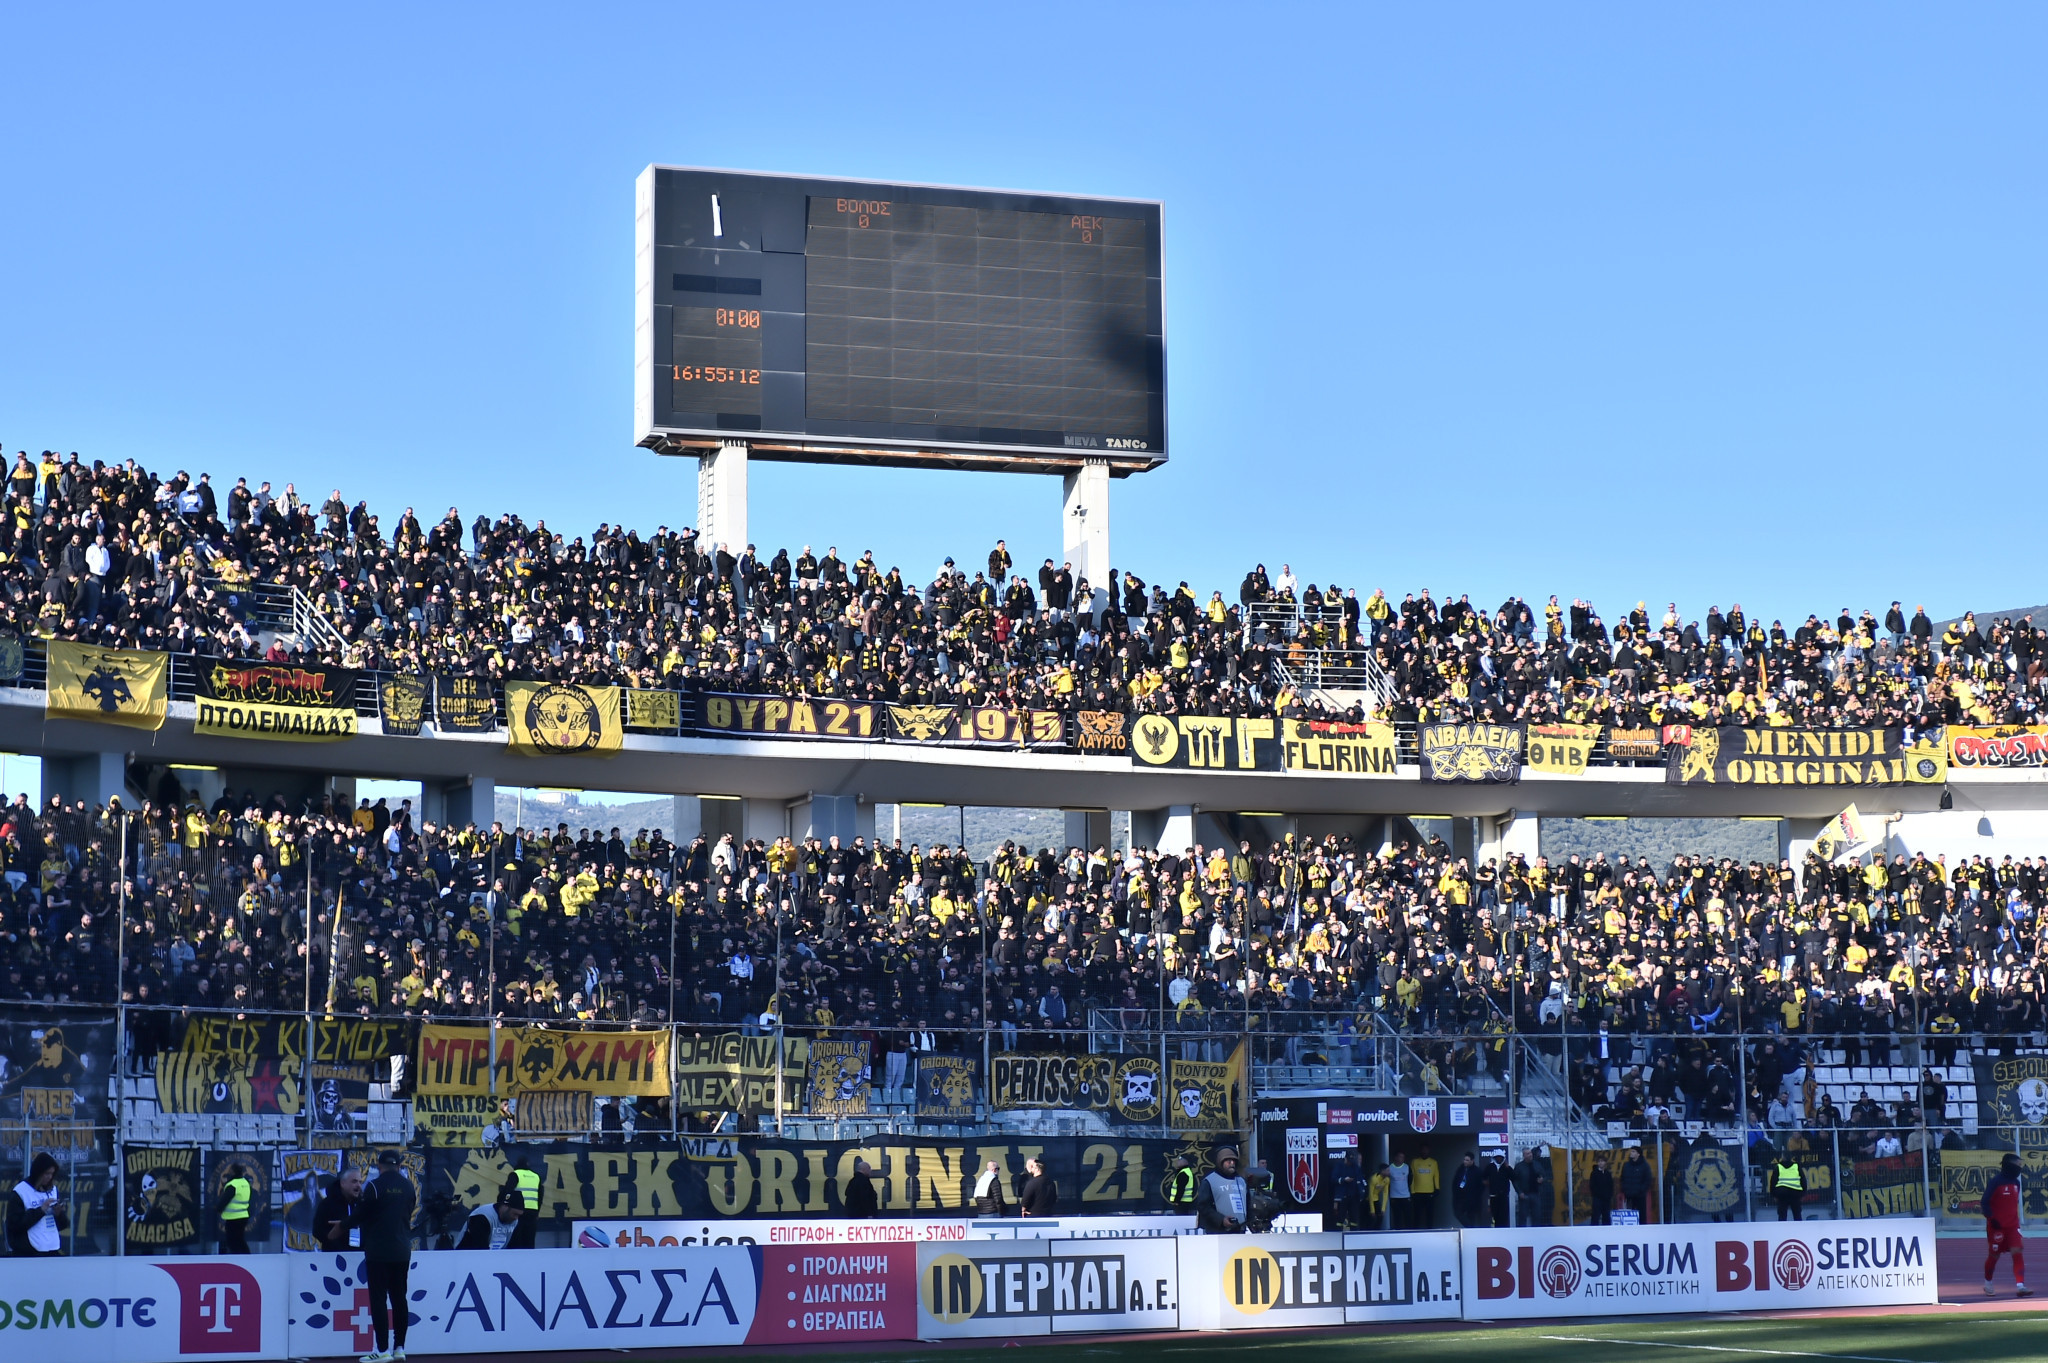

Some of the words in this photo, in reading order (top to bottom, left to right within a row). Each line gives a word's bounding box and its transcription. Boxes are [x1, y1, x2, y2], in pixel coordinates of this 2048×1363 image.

[859, 214, 870, 229] 0
[1082, 230, 1092, 243] 0
[716, 308, 760, 327] 0:00
[673, 365, 760, 385] 16:55:12
[1064, 435, 1098, 447] MEVA
[199, 703, 355, 737] ΠΤΟΛΕΜΑΪΔΑΣ
[706, 698, 819, 737] ΘΥΡΑ
[825, 703, 873, 738] 21
[957, 708, 1064, 741] 1975
[1077, 733, 1126, 750] ΛΑΥΡΙΟ
[1612, 745, 1654, 756] ORIGINAL
[1743, 729, 1887, 756] MENIDI
[1286, 741, 1395, 773] FLORINA
[182, 1018, 267, 1054] ΝΕΟΣ
[678, 1032, 806, 1070] ORIGINAL
[811, 1041, 855, 1062] ORIGINAL
[857, 1042, 869, 1062] 21
[920, 1056, 963, 1071] ORIGINAL
[965, 1057, 977, 1074] 21
[1175, 1064, 1228, 1078] ΠΟΝΤΟΣ
[23, 1088, 75, 1117] FREE
[415, 1094, 499, 1114] ALIARTOS
[430, 1114, 485, 1128] ORIGINAL
[1260, 1107, 1289, 1122] novibet
[1357, 1109, 1399, 1122] novibet
[444, 1130, 468, 1146] 21
[127, 1149, 194, 1174] ORIGINAL
[284, 1153, 338, 1176] ΜΑΡΙΟΣ
[1081, 1143, 1147, 1201] 21
[126, 1218, 195, 1243] ANACASA
[770, 1226, 834, 1243] ΕΠΙΓΡΑΦΗ
[847, 1225, 913, 1242] ΕΚΤΥΠΩΣΗ
[926, 1224, 966, 1241] STAND
[1585, 1241, 1698, 1278] SERUM
[1817, 1236, 1924, 1270] SERUM
[803, 1255, 888, 1276] ΠΡΟΛΗΨΗ
[1584, 1279, 1699, 1298] ΑΠΕΙΚΟΝΙΣΤΙΚΗ
[1817, 1272, 1925, 1289] ΑΠΕΙΚΟΝΙΣΤΙΚΗ
[802, 1283, 887, 1304] ΔΙΑΓΝΩΣΗ
[803, 1311, 886, 1331] ΘΕΡΑΠΕΙΑ
